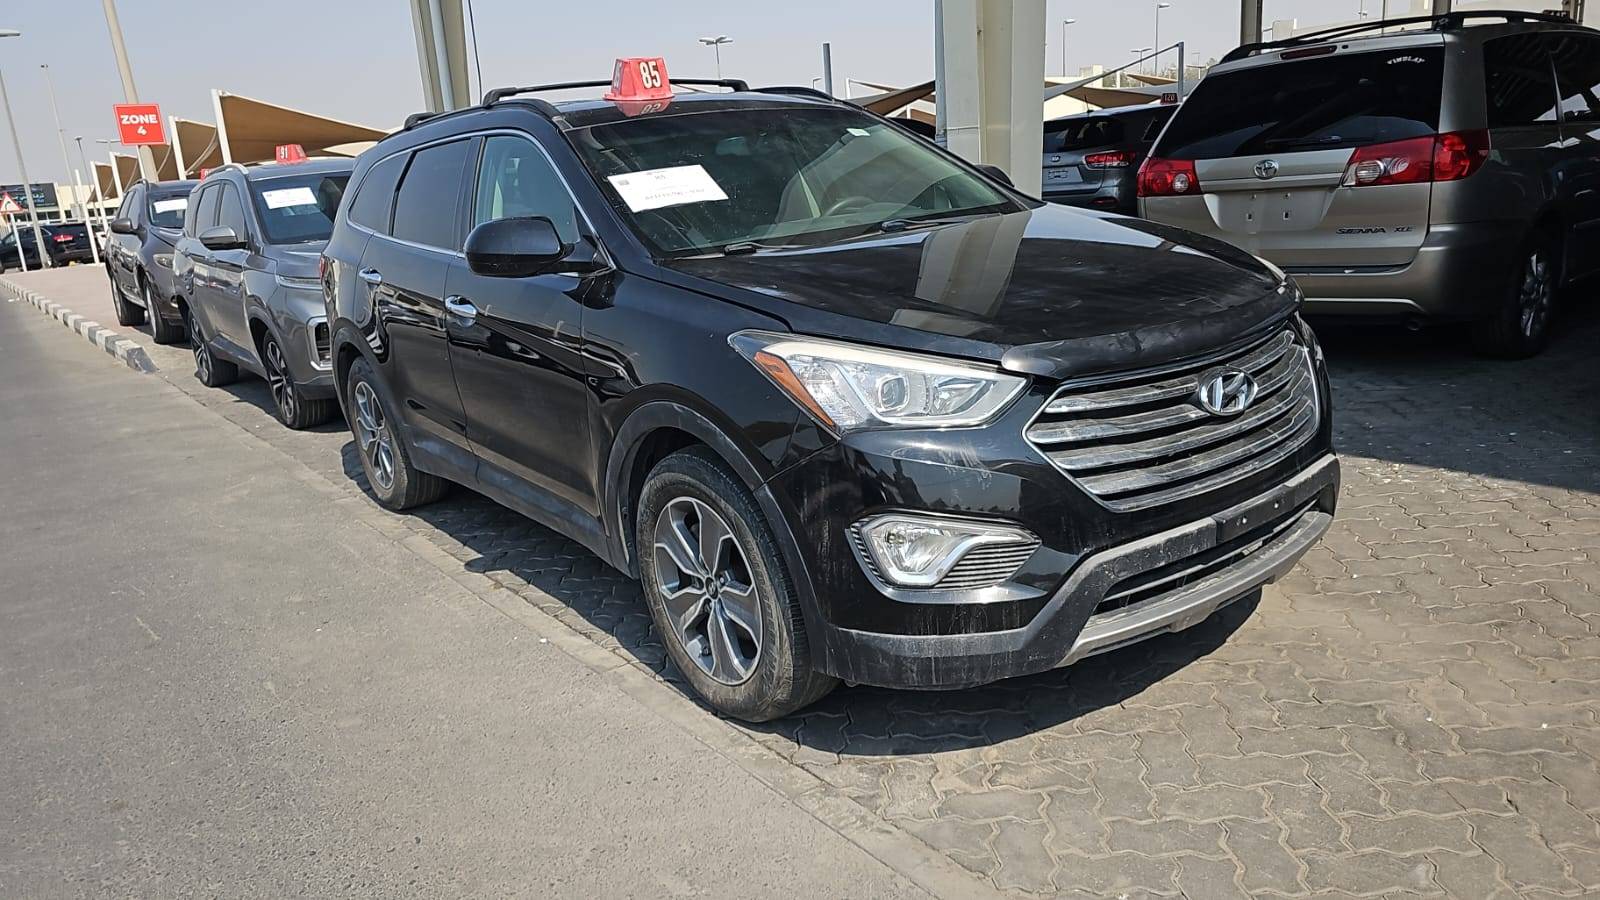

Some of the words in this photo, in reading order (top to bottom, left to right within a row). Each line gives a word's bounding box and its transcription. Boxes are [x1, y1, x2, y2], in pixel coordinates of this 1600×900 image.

[640, 61, 662, 89] 85
[120, 114, 158, 124] ZONE
[137, 127, 147, 136] 4
[279, 146, 288, 159] 91
[1336, 227, 1386, 235] SIENNA
[1394, 225, 1414, 233] XLE
